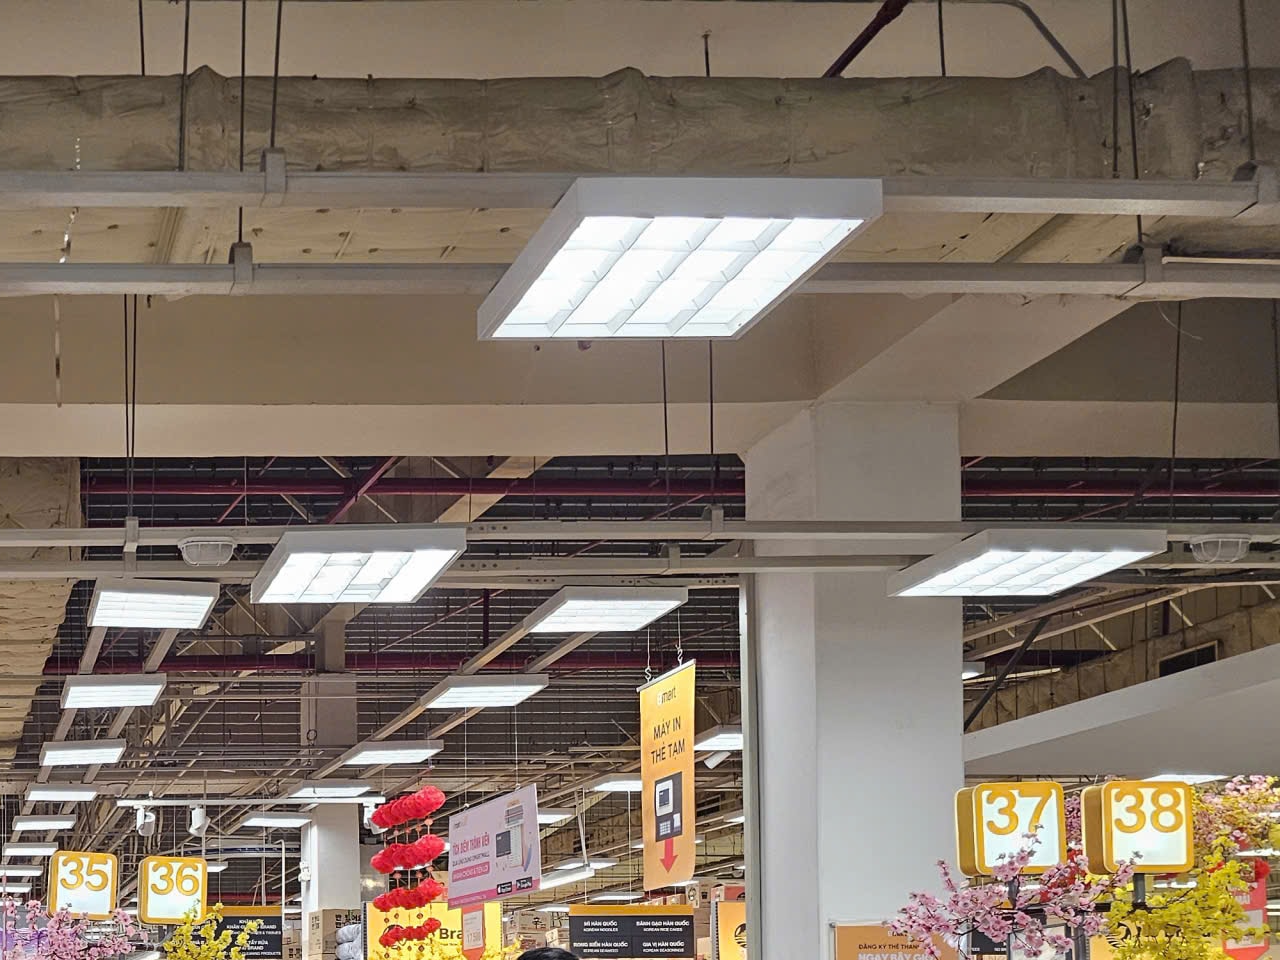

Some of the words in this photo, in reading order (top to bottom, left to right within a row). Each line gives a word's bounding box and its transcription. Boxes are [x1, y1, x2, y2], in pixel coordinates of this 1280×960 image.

[653, 718, 671, 741] MÁY
[672, 716, 682, 732] IN
[650, 741, 666, 766] THẺ
[667, 737, 686, 762] TẠM
[986, 788, 1053, 836] 37
[1113, 786, 1184, 834] 38
[60, 855, 109, 892] 35
[150, 862, 200, 896] 36
[439, 928, 463, 940] Bra
